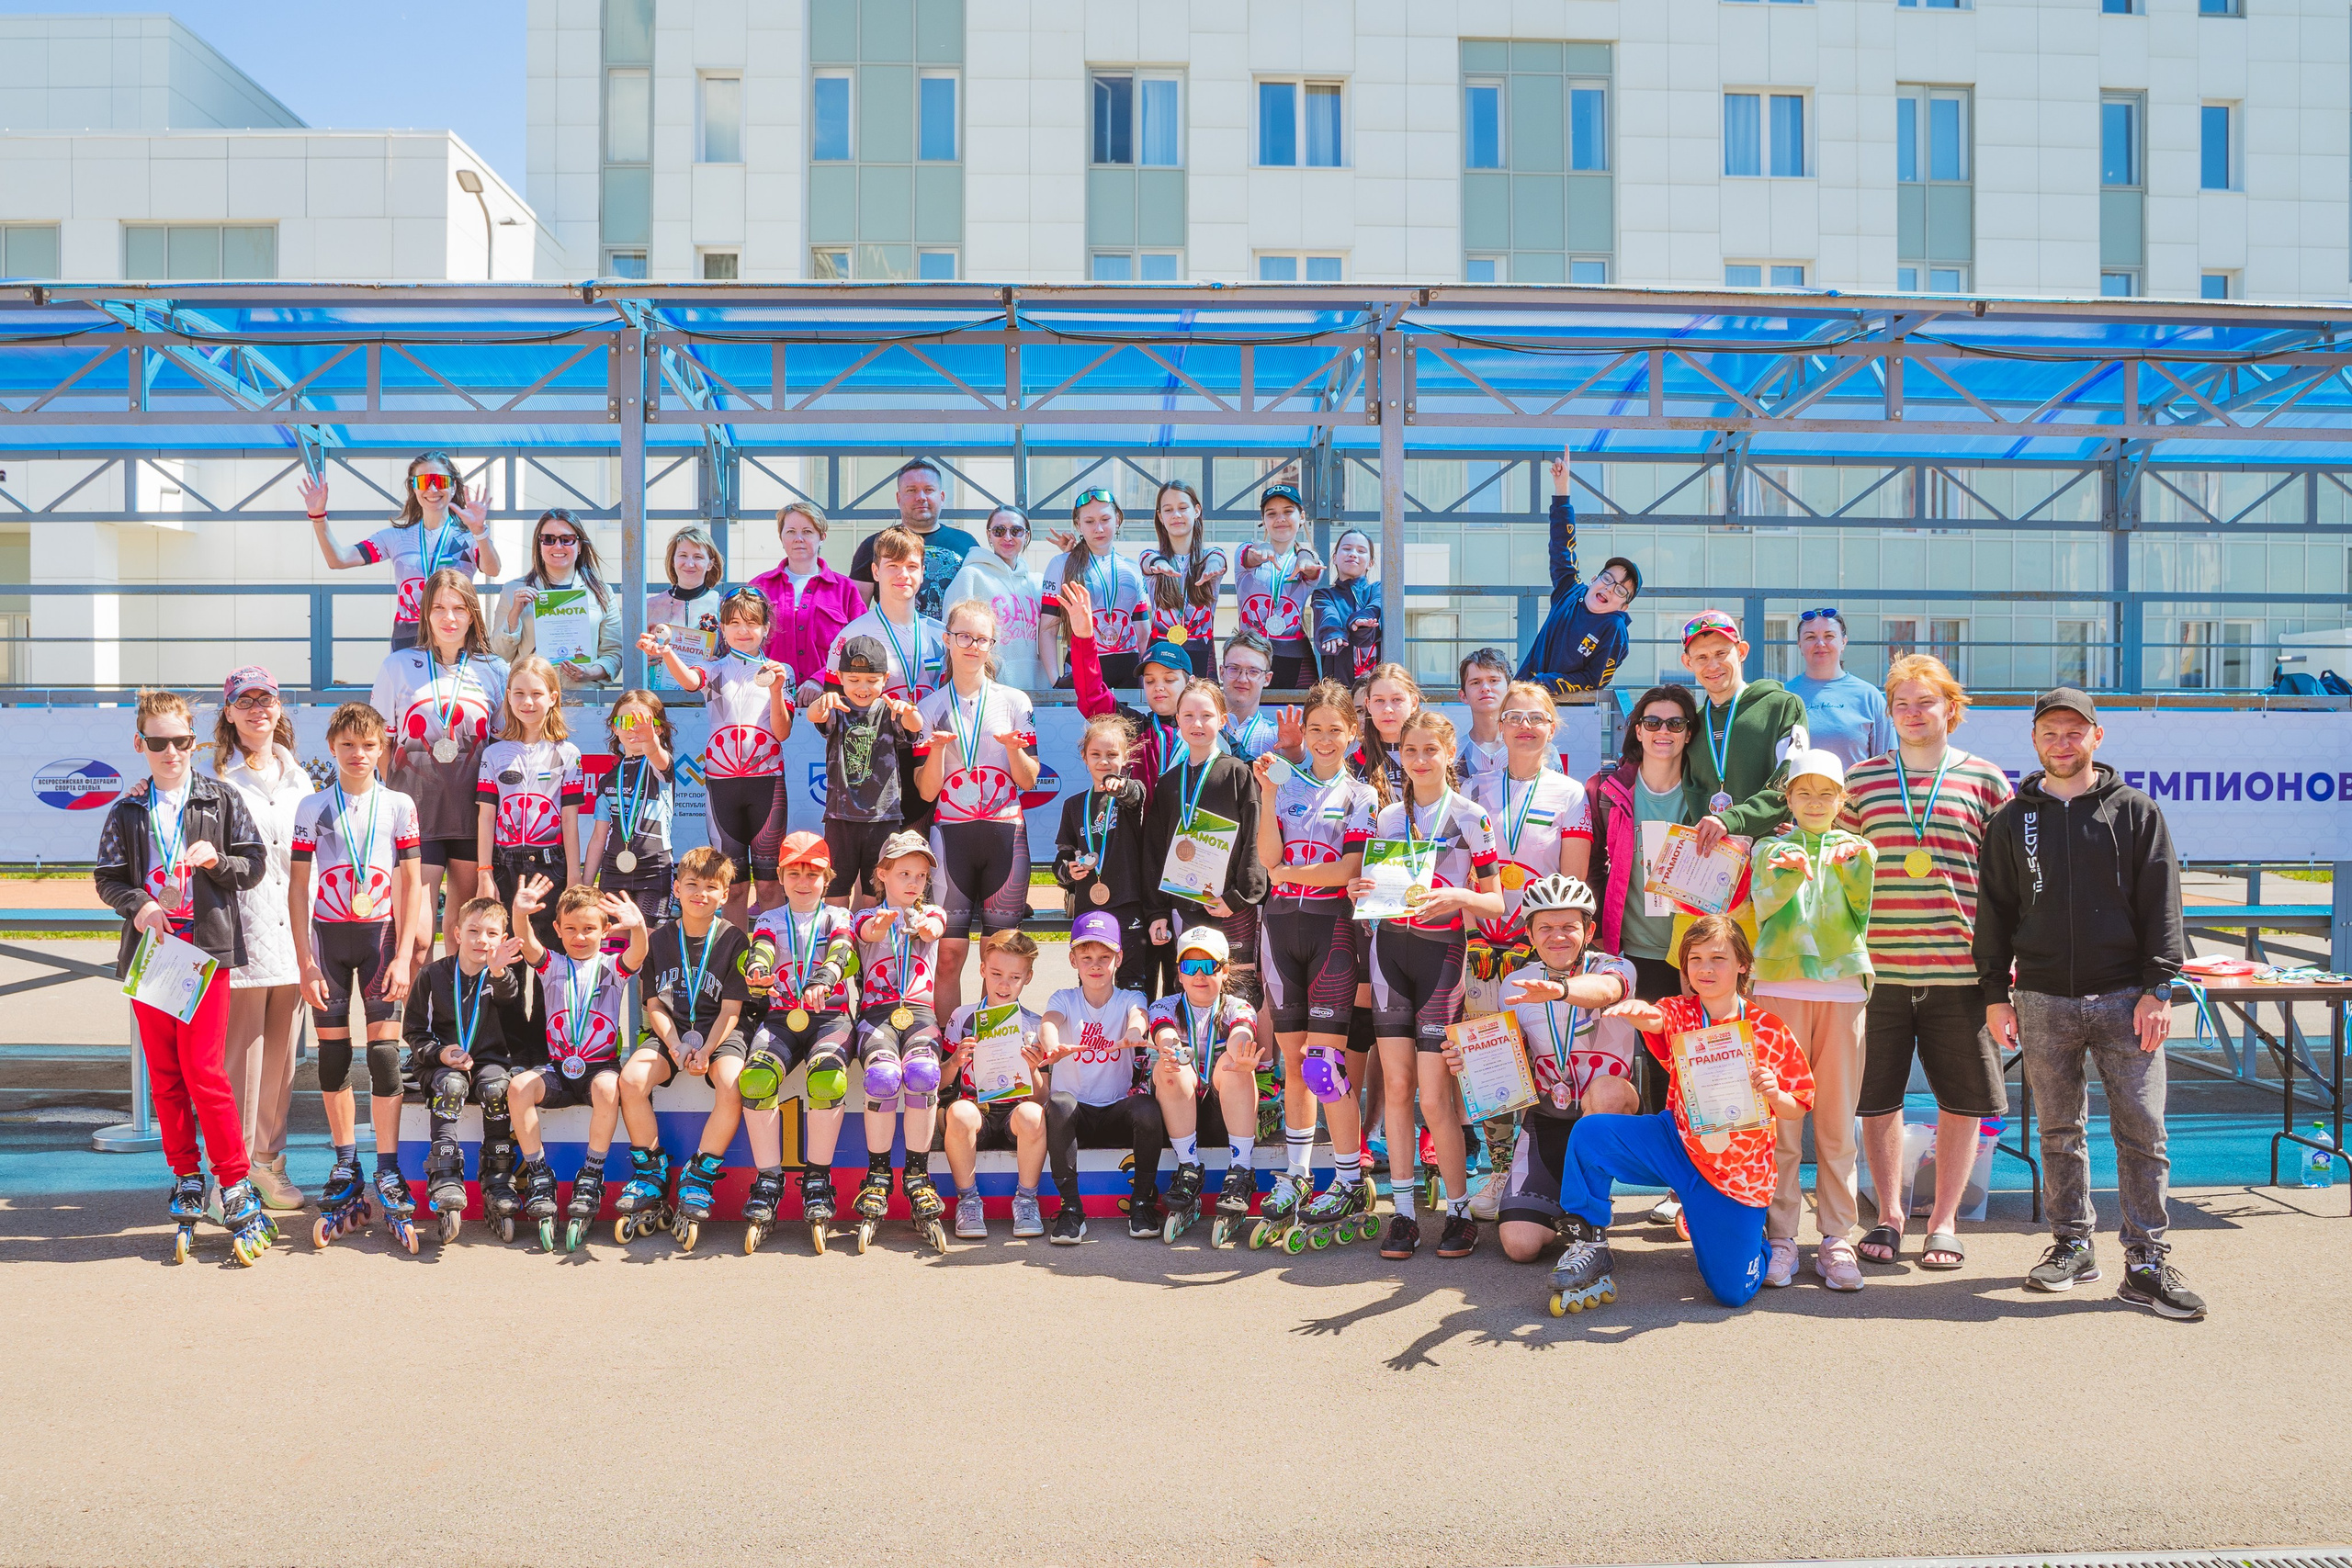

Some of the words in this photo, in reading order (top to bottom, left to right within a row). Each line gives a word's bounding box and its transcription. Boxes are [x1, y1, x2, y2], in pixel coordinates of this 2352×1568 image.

[536, 606, 587, 616] ГРАМОТА
[2117, 772, 2352, 801] ЕМПИОНОВ
[1660, 839, 1686, 885] ГРАМОТА
[977, 1024, 1020, 1041] ГРАМОТА
[1462, 1035, 1510, 1055] ГРАМОТА
[1689, 1048, 1745, 1066] ГРАМОТА
